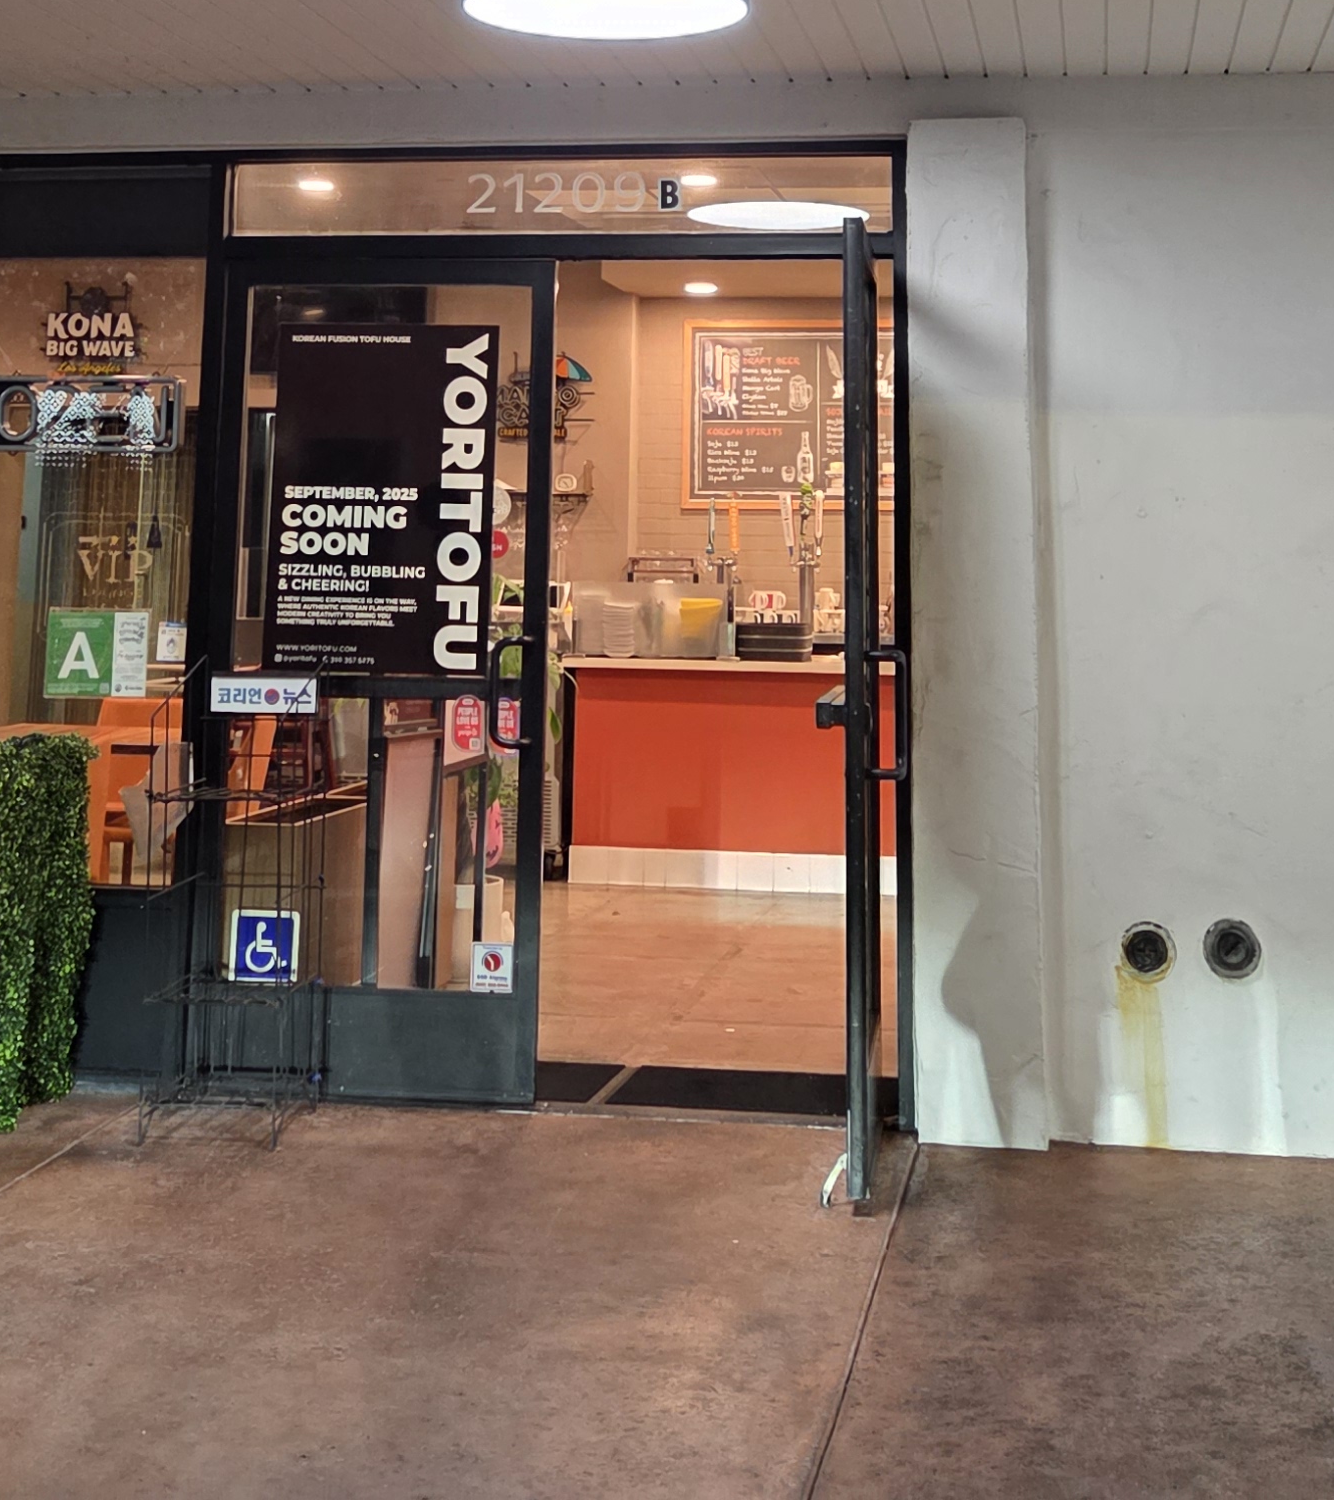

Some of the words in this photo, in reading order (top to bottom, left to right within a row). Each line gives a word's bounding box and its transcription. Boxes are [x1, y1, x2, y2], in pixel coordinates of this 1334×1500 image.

[466, 171, 647, 214] 21209
[660, 179, 680, 210] B
[46, 312, 135, 339] KONA
[45, 340, 79, 357] BIG
[81, 340, 136, 357] WAVE
[284, 485, 380, 503] SEPTEMBER,
[382, 487, 418, 501] 2025
[433, 332, 490, 671] YORITOFU
[281, 503, 408, 530] COMING
[279, 531, 370, 556] SOON
[77, 549, 154, 584] VIP
[278, 563, 347, 579] SIZZLING,
[350, 565, 426, 579] BUBBLING
[277, 578, 288, 591] &
[291, 578, 370, 592] CHEERING!
[57, 631, 100, 680] A
[217, 687, 262, 706] 코리언
[282, 688, 313, 706] 뉴스
